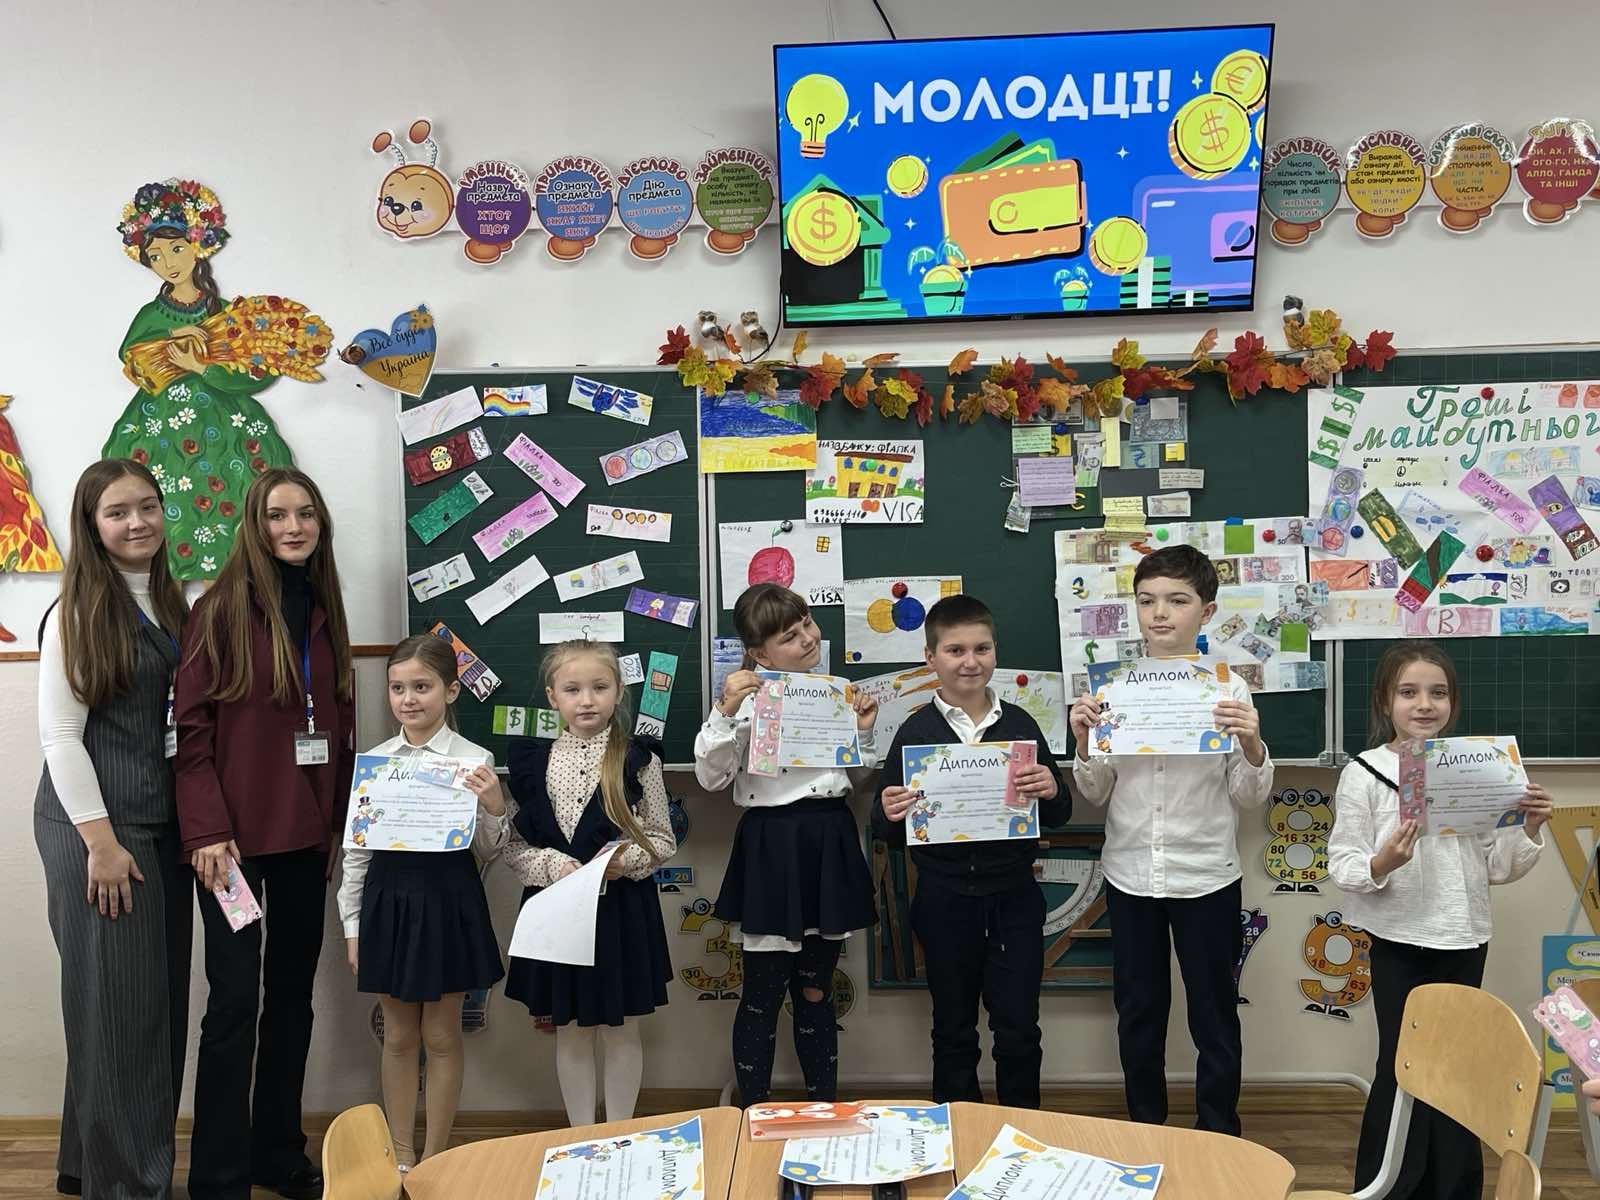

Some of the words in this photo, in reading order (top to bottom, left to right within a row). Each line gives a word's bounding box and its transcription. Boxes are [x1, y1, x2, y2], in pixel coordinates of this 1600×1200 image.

[873, 68, 1172, 125] МОЛОДЦІ!
[1347, 133, 1426, 169] РИСЛІВНИК
[695, 150, 772, 183] ЗАЙМЕННИК
[535, 158, 613, 194] ПРИКМЕТНИК
[618, 159, 687, 187] ДІЄСЛОВО
[477, 182, 509, 193] Назву
[554, 181, 593, 192] Ознаку
[642, 180, 665, 191] Дію
[467, 193, 520, 203] предмета
[549, 190, 601, 203] предмета
[629, 189, 681, 202] предмета
[477, 210, 512, 221] ХТО?
[479, 224, 509, 235] ЩО?
[380, 350, 430, 378] Україна
[1407, 386, 1532, 431] Гроші
[883, 501, 924, 521] VISA
[1103, 606, 1124, 616] 500
[1126, 670, 1190, 685] Диплом
[784, 685, 828, 698] Диплом
[939, 757, 1000, 772] Диплом
[1437, 752, 1495, 768] Диплом
[1277, 822, 1285, 831] 8
[1313, 822, 1328, 831] 24
[1284, 834, 1297, 842] 16
[1302, 834, 1316, 843] 32
[1271, 845, 1284, 854] 80
[1268, 859, 1281, 867] 72
[1280, 870, 1294, 878] 64
[1302, 871, 1316, 880] 56
[1246, 927, 1259, 936] 28
[713, 940, 727, 949] 12
[1354, 939, 1368, 949] 36
[1307, 946, 1315, 956] 9
[1312, 959, 1326, 968] 18
[686, 969, 700, 978] 30
[1356, 966, 1371, 976] 54
[713, 979, 727, 988] 24
[1350, 980, 1366, 991] 63
[658, 1150, 682, 1189] Диплом
